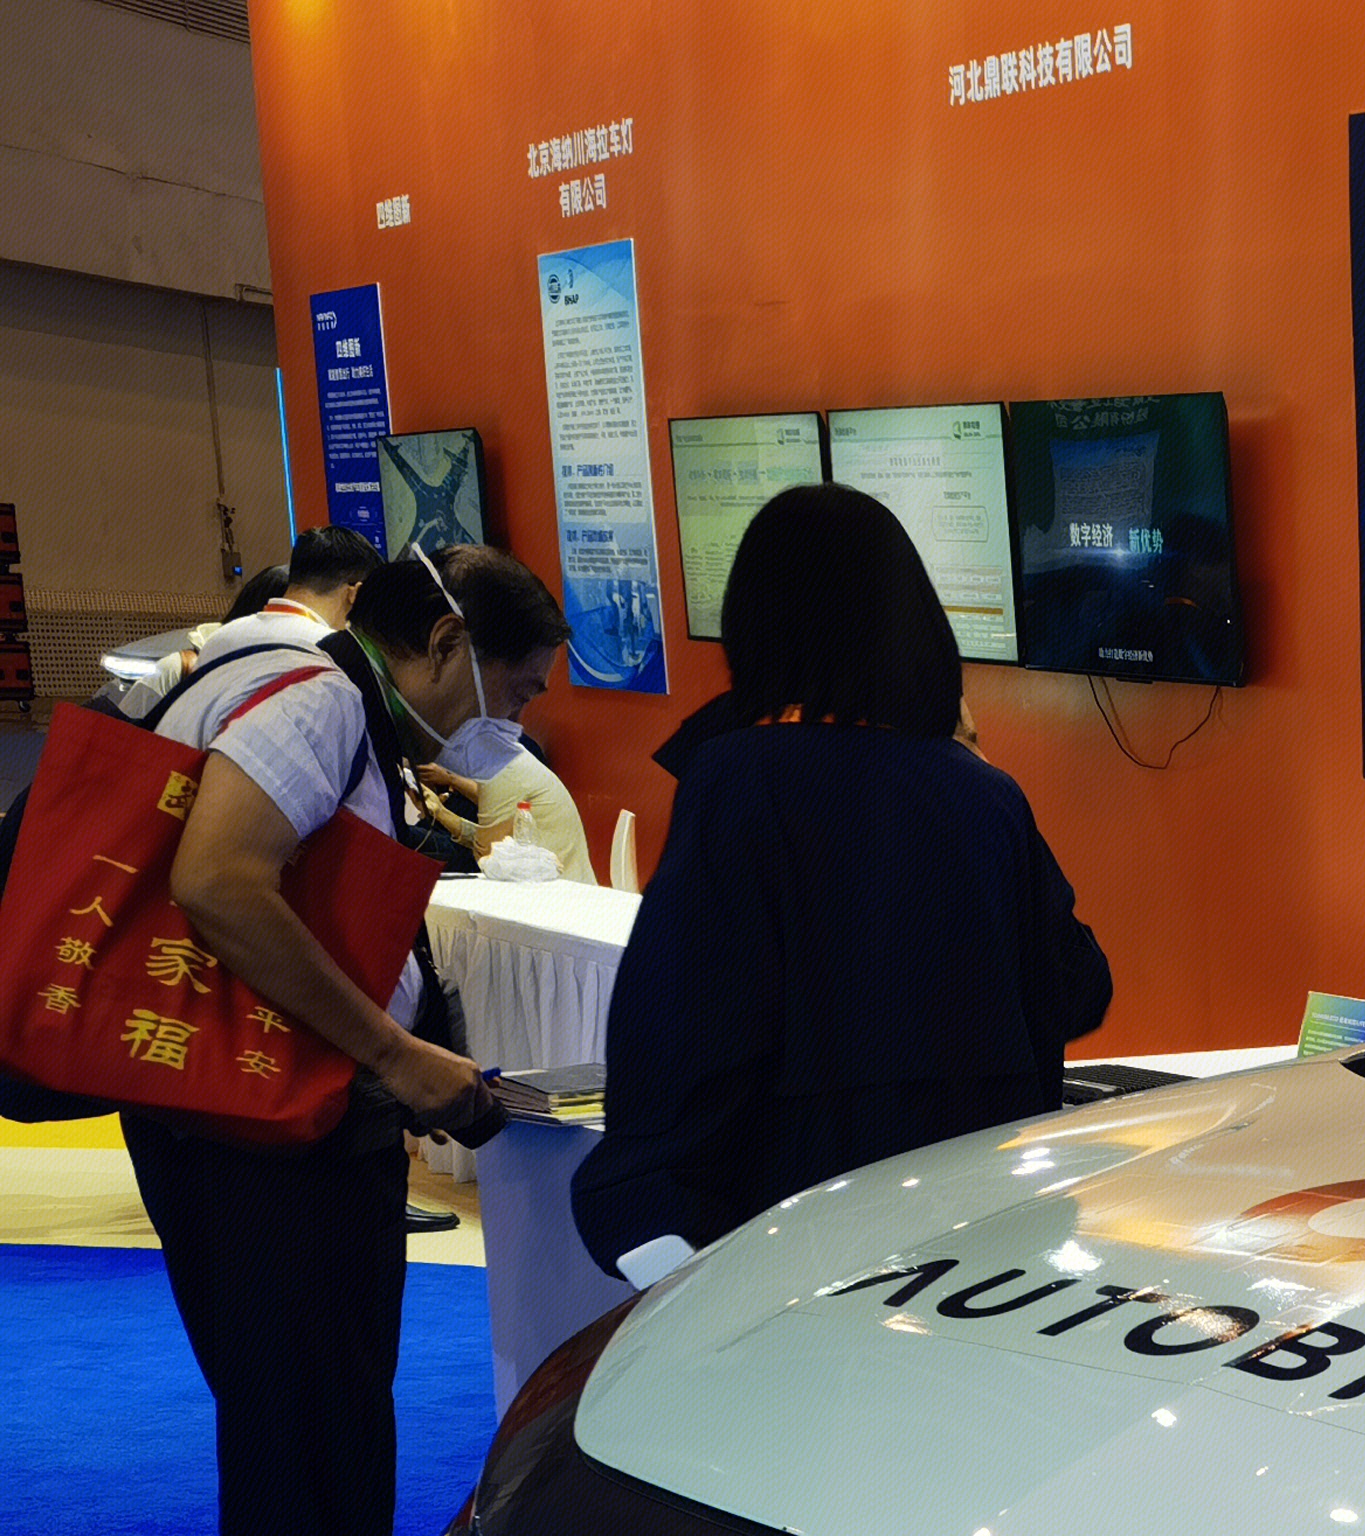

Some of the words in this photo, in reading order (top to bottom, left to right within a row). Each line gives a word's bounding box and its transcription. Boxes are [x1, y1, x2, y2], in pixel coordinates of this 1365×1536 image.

[949, 22, 1133, 107] 河北鼎联科技有限公司
[527, 118, 634, 180] 北京海纳川海拉车灯
[559, 173, 607, 219] 有限公司
[1069, 522, 1114, 549] 数字经济
[1128, 528, 1164, 555] 新优势
